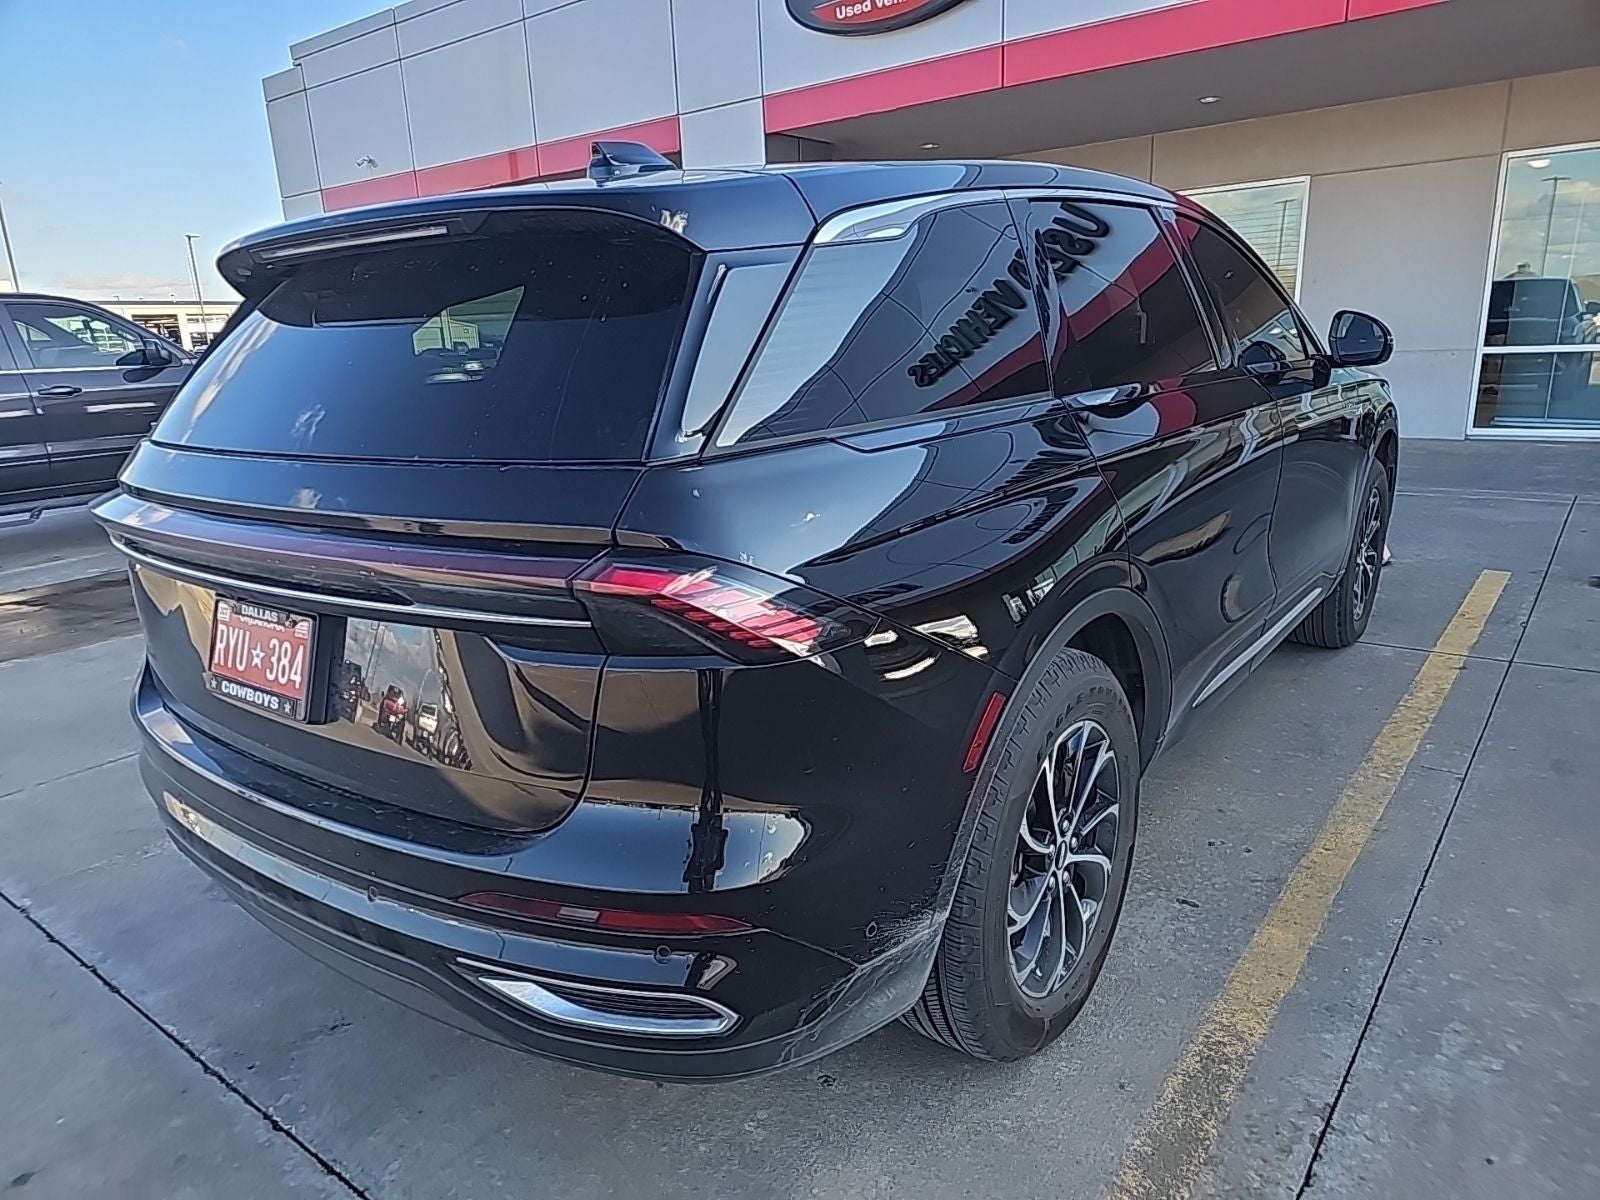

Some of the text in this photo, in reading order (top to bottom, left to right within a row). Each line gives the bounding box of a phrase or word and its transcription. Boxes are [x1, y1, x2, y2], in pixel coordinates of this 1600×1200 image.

[836, 0, 871, 19] Used
[241, 604, 278, 622] DALLAS
[213, 624, 304, 689] RYU 384
[221, 680, 279, 710] COWBOYS
